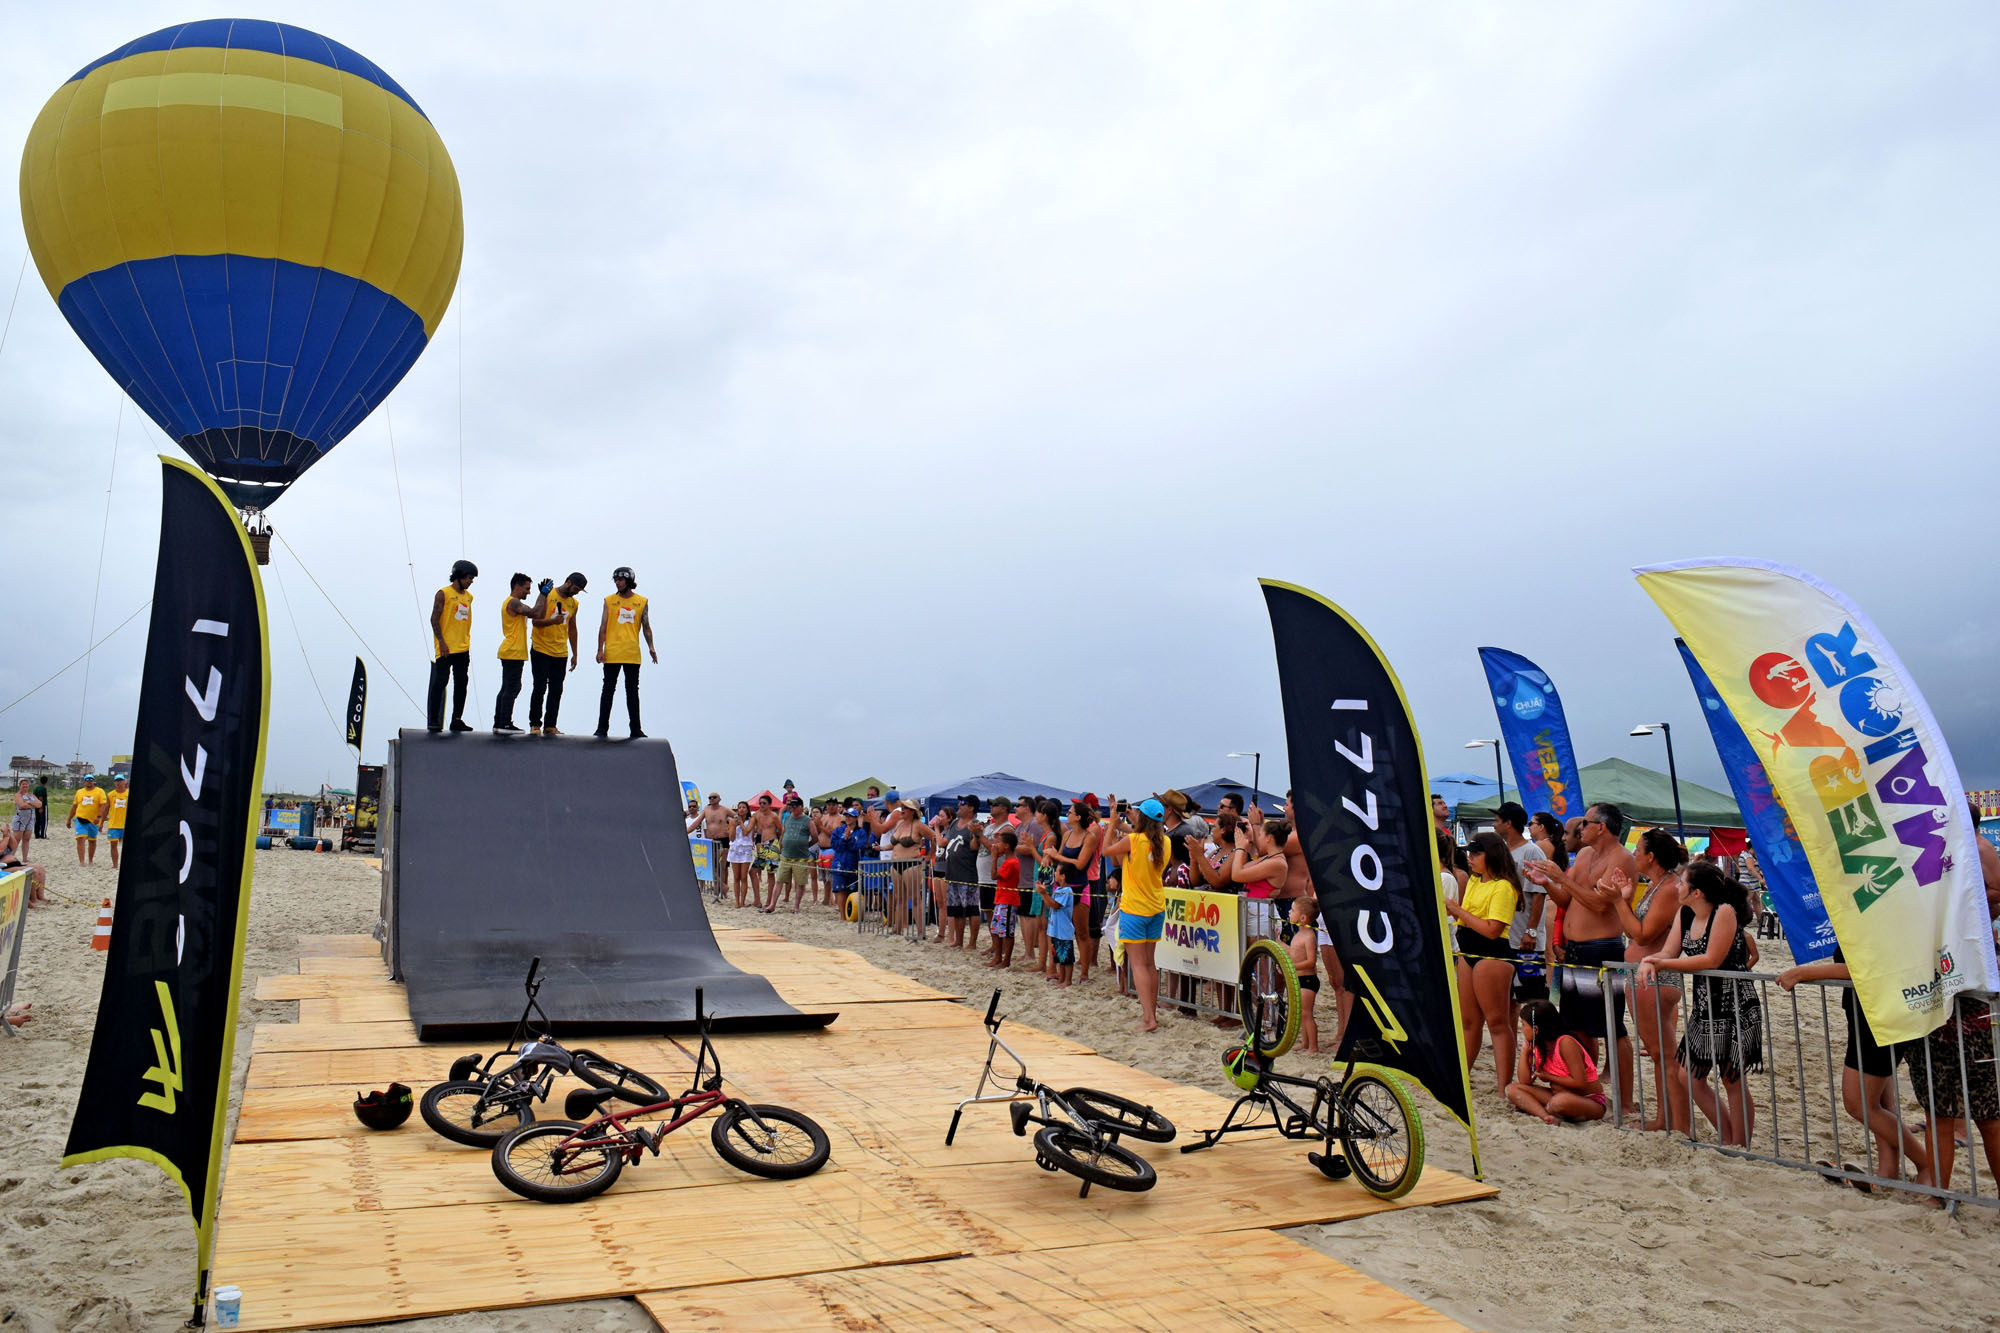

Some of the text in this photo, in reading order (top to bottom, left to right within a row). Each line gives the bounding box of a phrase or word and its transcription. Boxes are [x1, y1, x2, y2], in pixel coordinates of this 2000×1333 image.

[1805, 620, 1954, 886] MAIOR
[1331, 699, 1394, 955] COLLI
[1165, 894, 1220, 927] VERÃO
[1165, 922, 1220, 953] MAIOR
[1808, 936, 1838, 950] SANE
